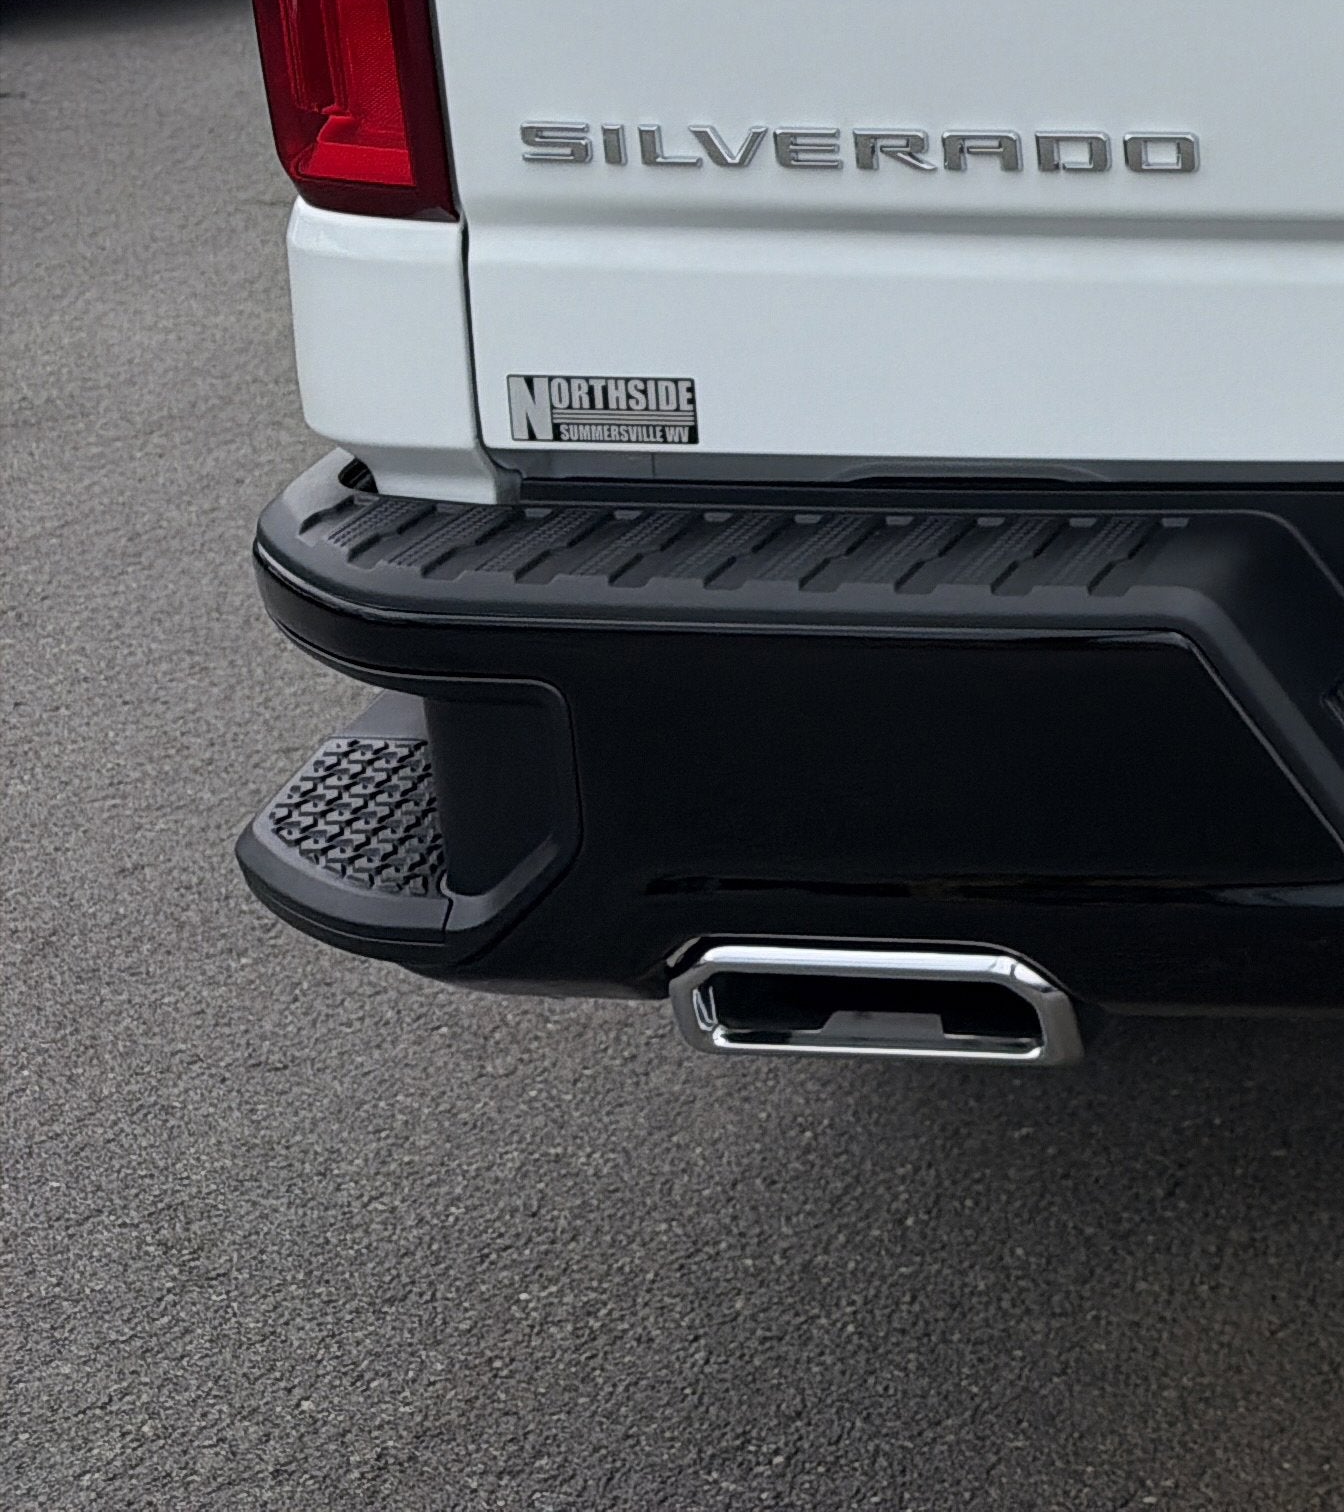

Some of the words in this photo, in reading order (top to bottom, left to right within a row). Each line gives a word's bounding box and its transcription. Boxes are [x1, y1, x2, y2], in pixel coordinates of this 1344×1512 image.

[520, 121, 1200, 173] SILVERADO
[508, 376, 694, 440] NORTHSIDE
[560, 424, 664, 442] SUMMERSVILLE
[665, 426, 690, 443] WV
